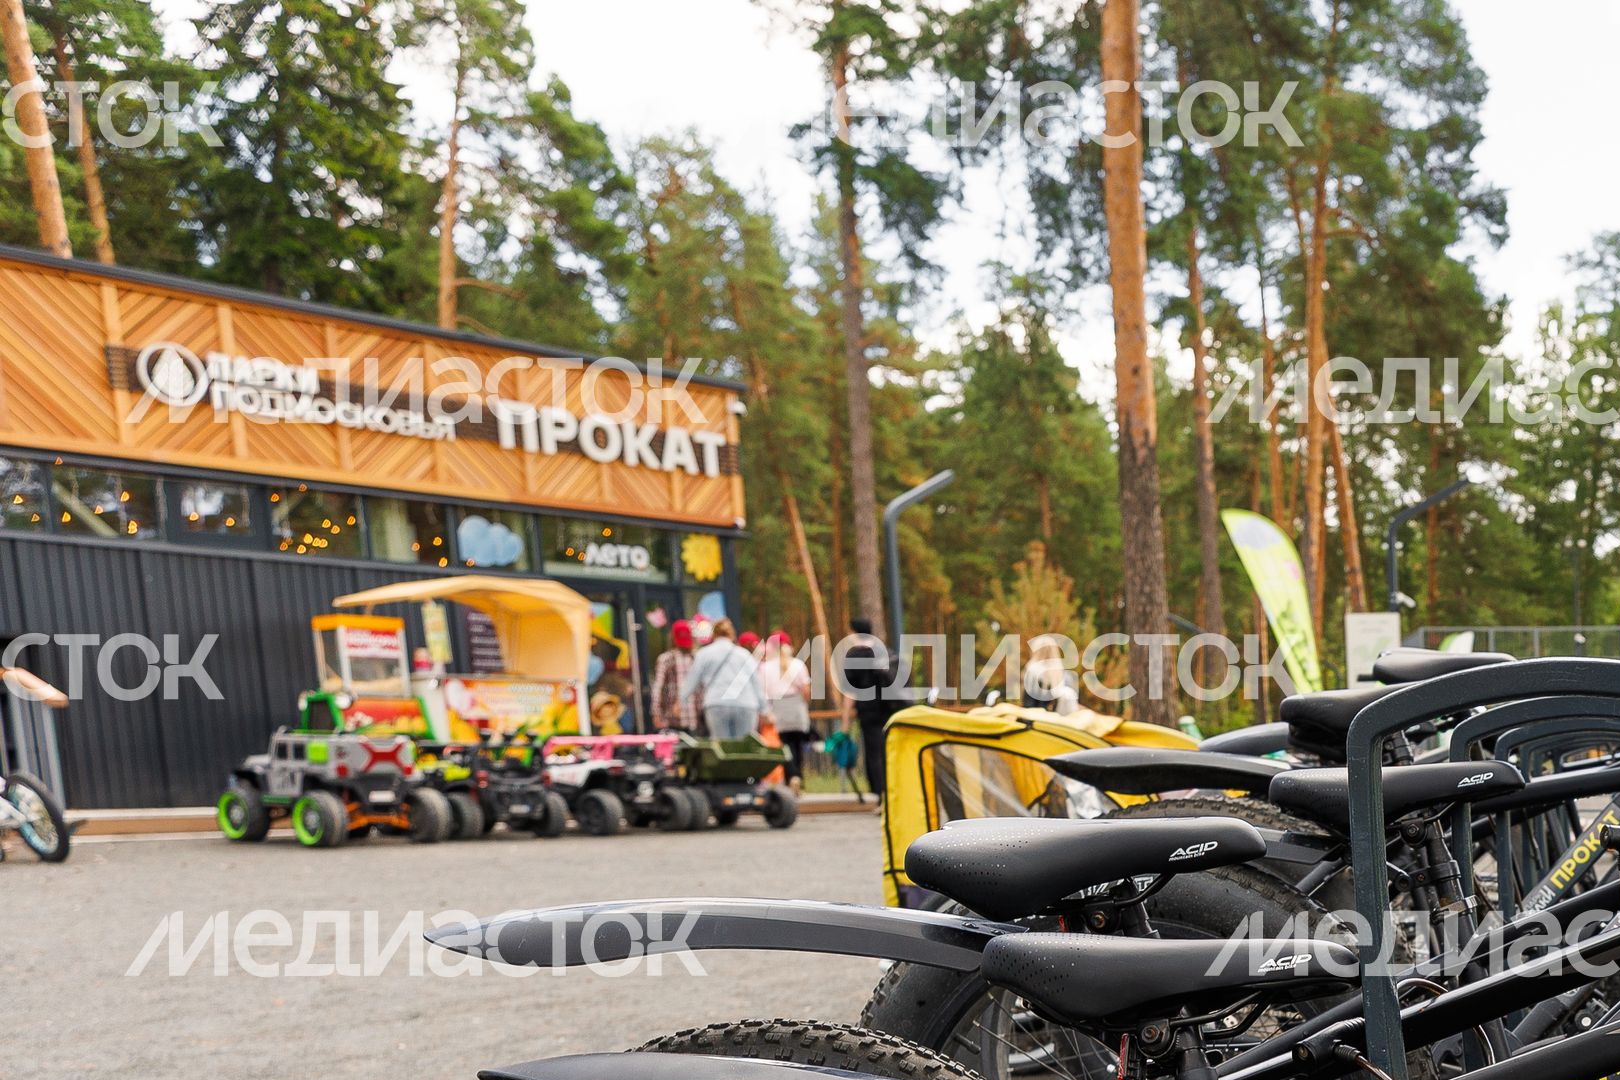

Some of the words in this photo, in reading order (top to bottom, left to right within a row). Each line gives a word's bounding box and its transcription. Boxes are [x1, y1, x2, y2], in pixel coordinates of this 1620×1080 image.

[207, 353, 320, 394] ПАРКИ
[210, 381, 456, 441] ПОДМОСКОВЬЯ
[498, 400, 726, 477] ПРОКАТ
[1458, 772, 1494, 785] ACID
[1170, 841, 1219, 858] ACID
[1550, 809, 1620, 890] ПРОКТ
[1259, 953, 1313, 968] ACID
